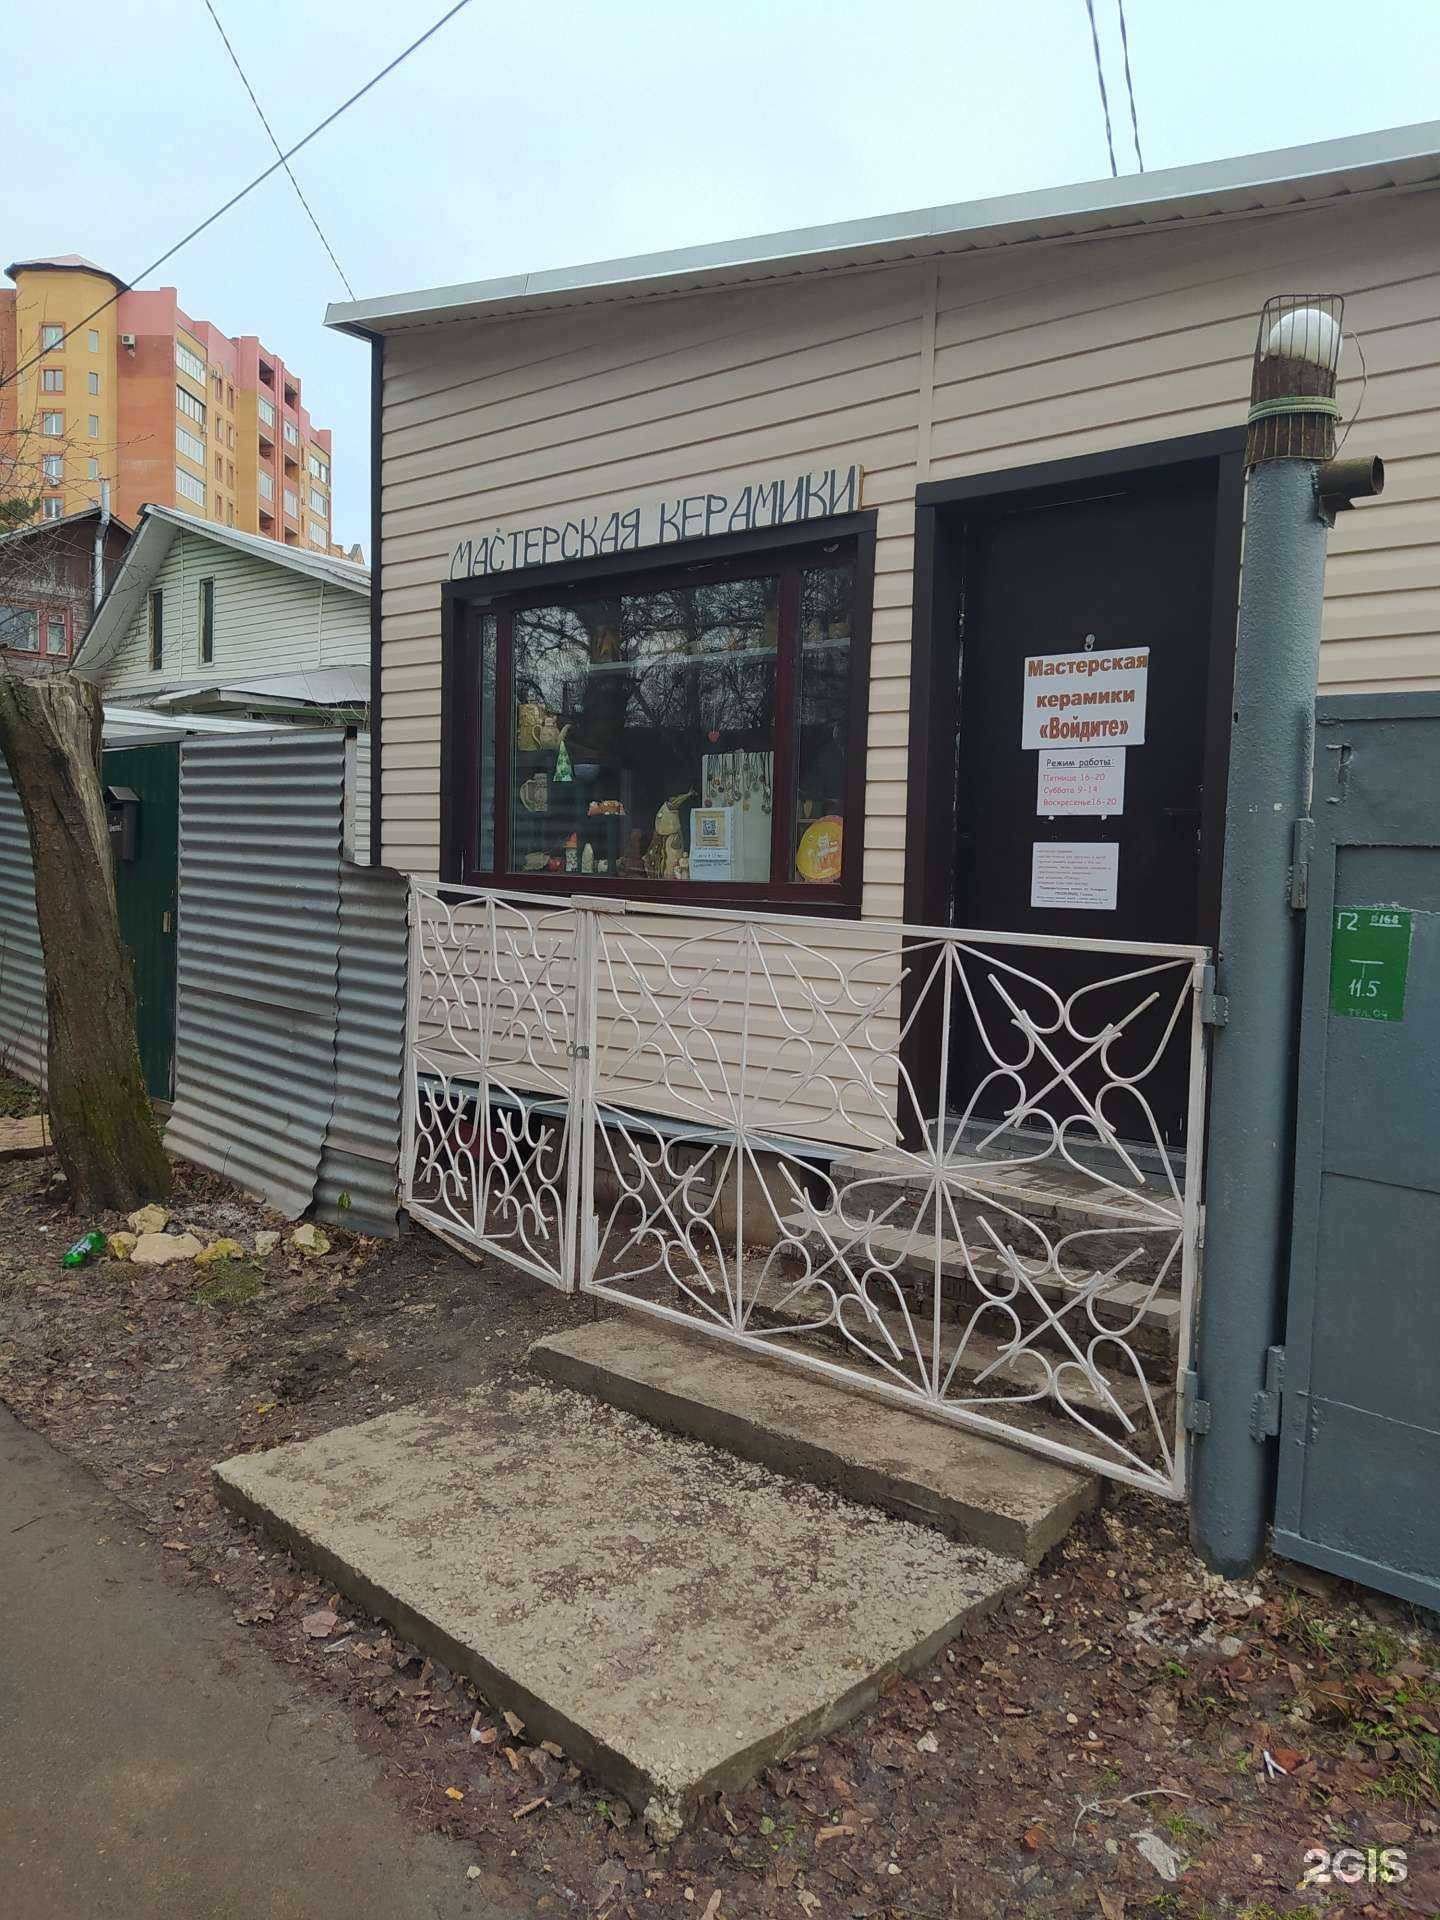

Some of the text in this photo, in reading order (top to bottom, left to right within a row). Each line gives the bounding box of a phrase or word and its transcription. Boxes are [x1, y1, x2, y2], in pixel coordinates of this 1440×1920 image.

[450, 465, 856, 580] МАСТЕРСКАЯ КЕРАМИКИ
[1028, 655, 1148, 677] Мастерская
[1036, 690, 1135, 711] керамики
[1040, 716, 1129, 742] «Войдите»
[1046, 758, 1075, 767] Режим
